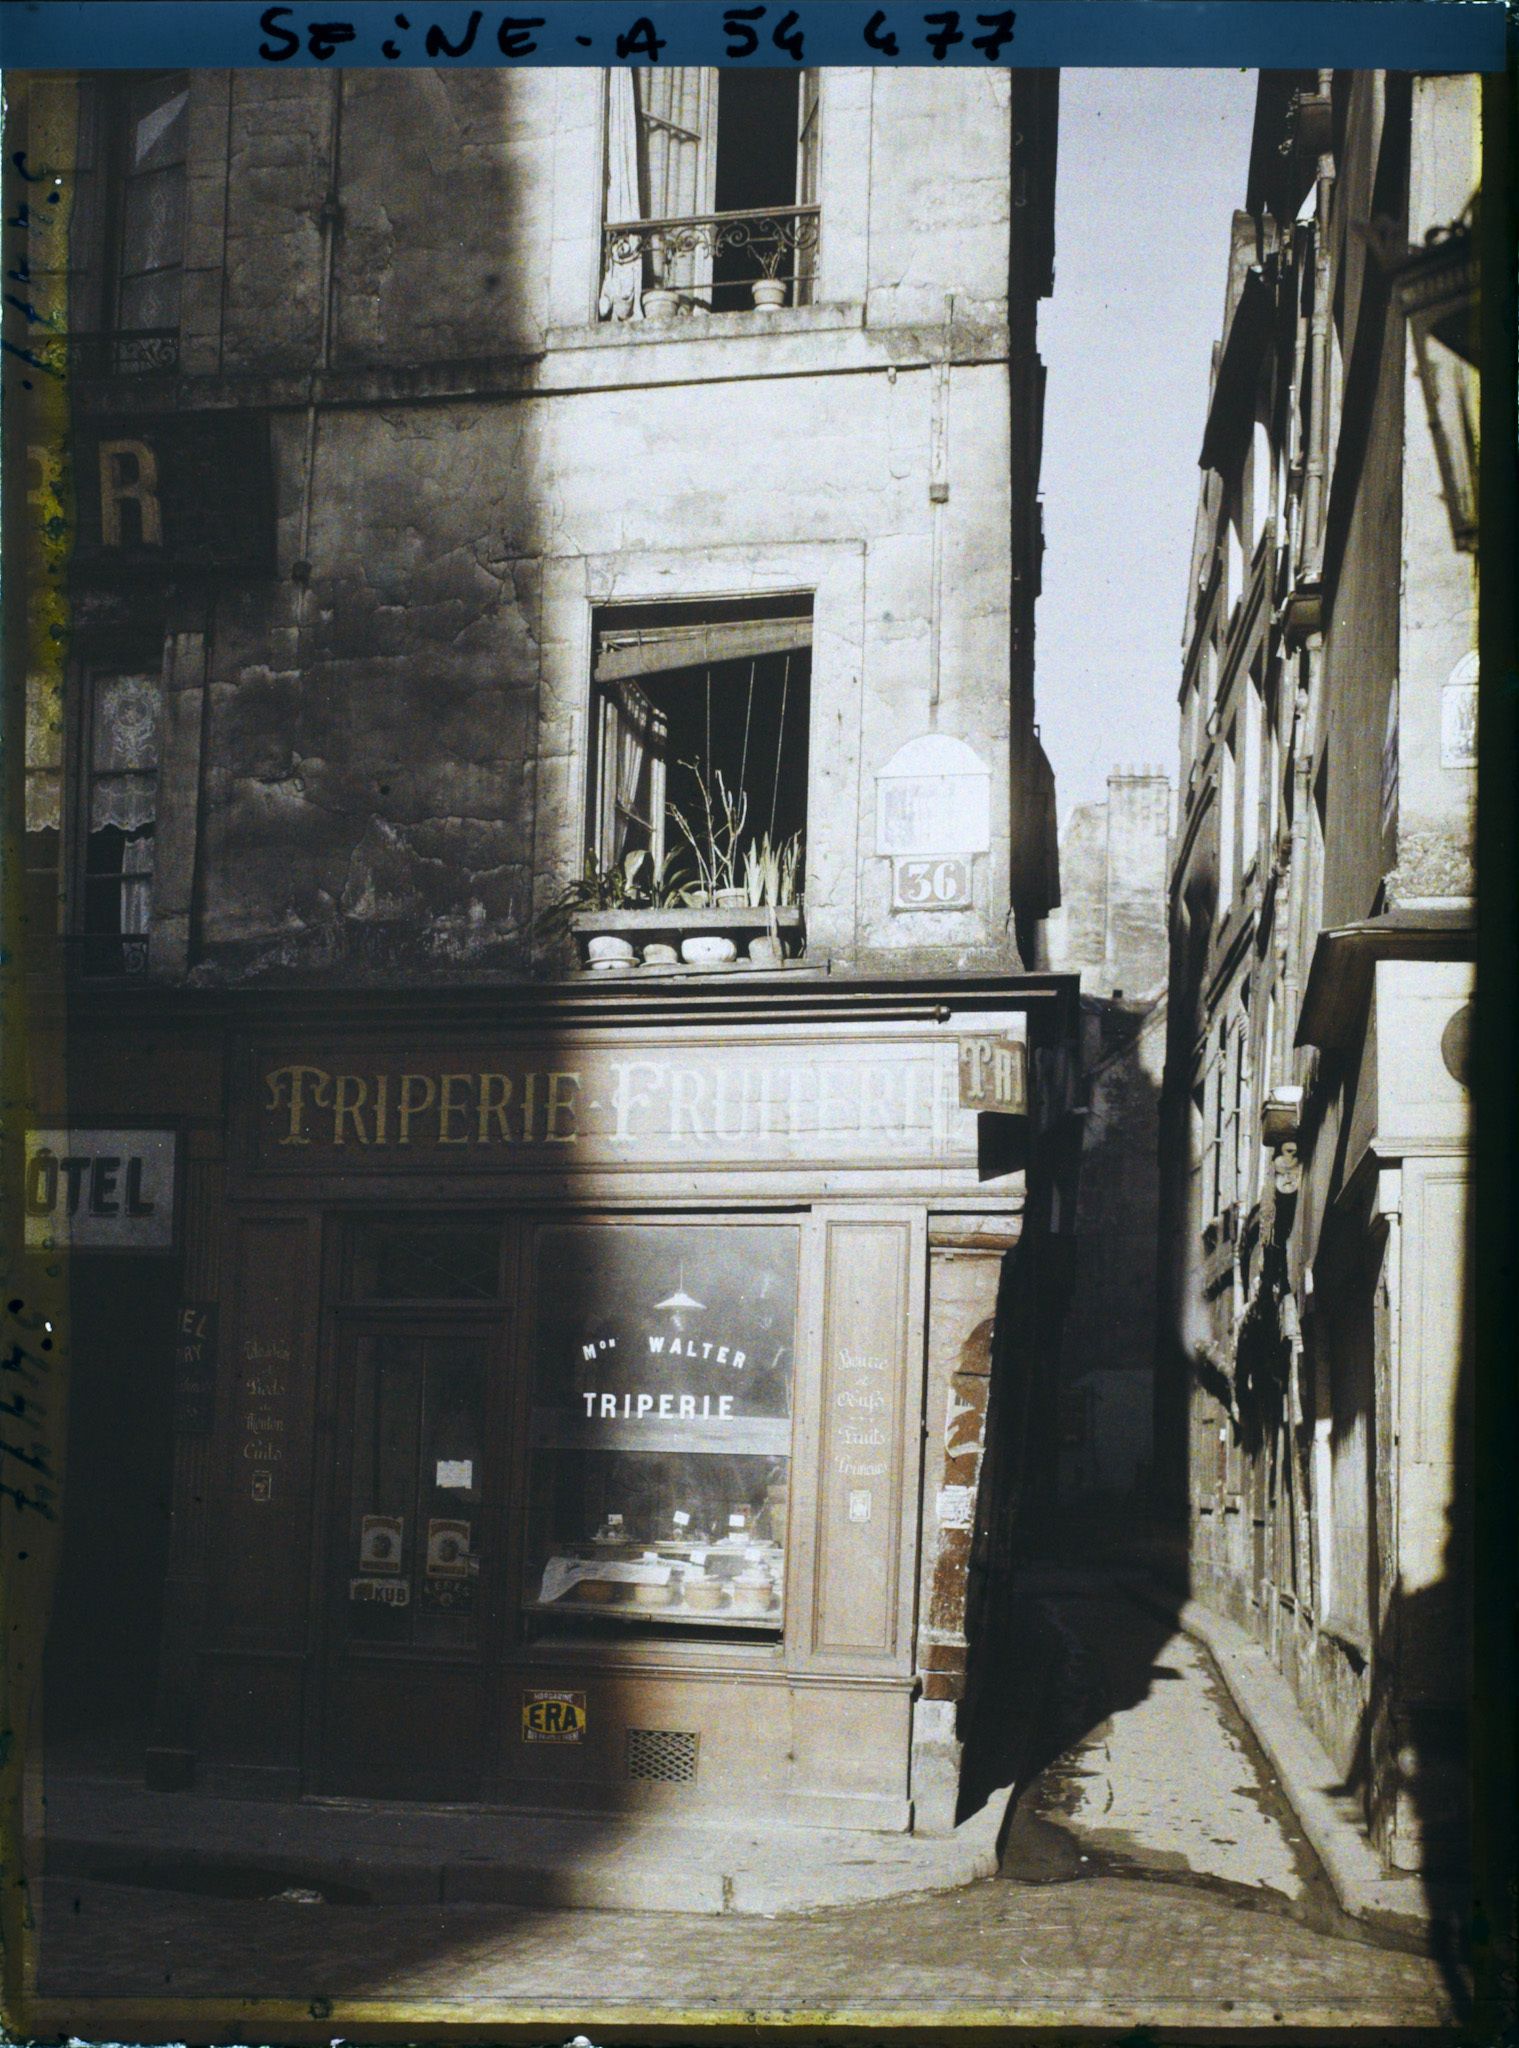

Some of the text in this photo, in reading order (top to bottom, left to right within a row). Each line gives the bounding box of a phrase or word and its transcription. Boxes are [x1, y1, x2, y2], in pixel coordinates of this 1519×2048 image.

[908, 862, 957, 900] 36
[177, 1307, 208, 1340] EL
[648, 1336, 747, 1369] WALTER
[582, 1392, 735, 1421] TRIPERIE
[374, 1587, 406, 1603] KUB
[529, 1702, 578, 1732] ERA
